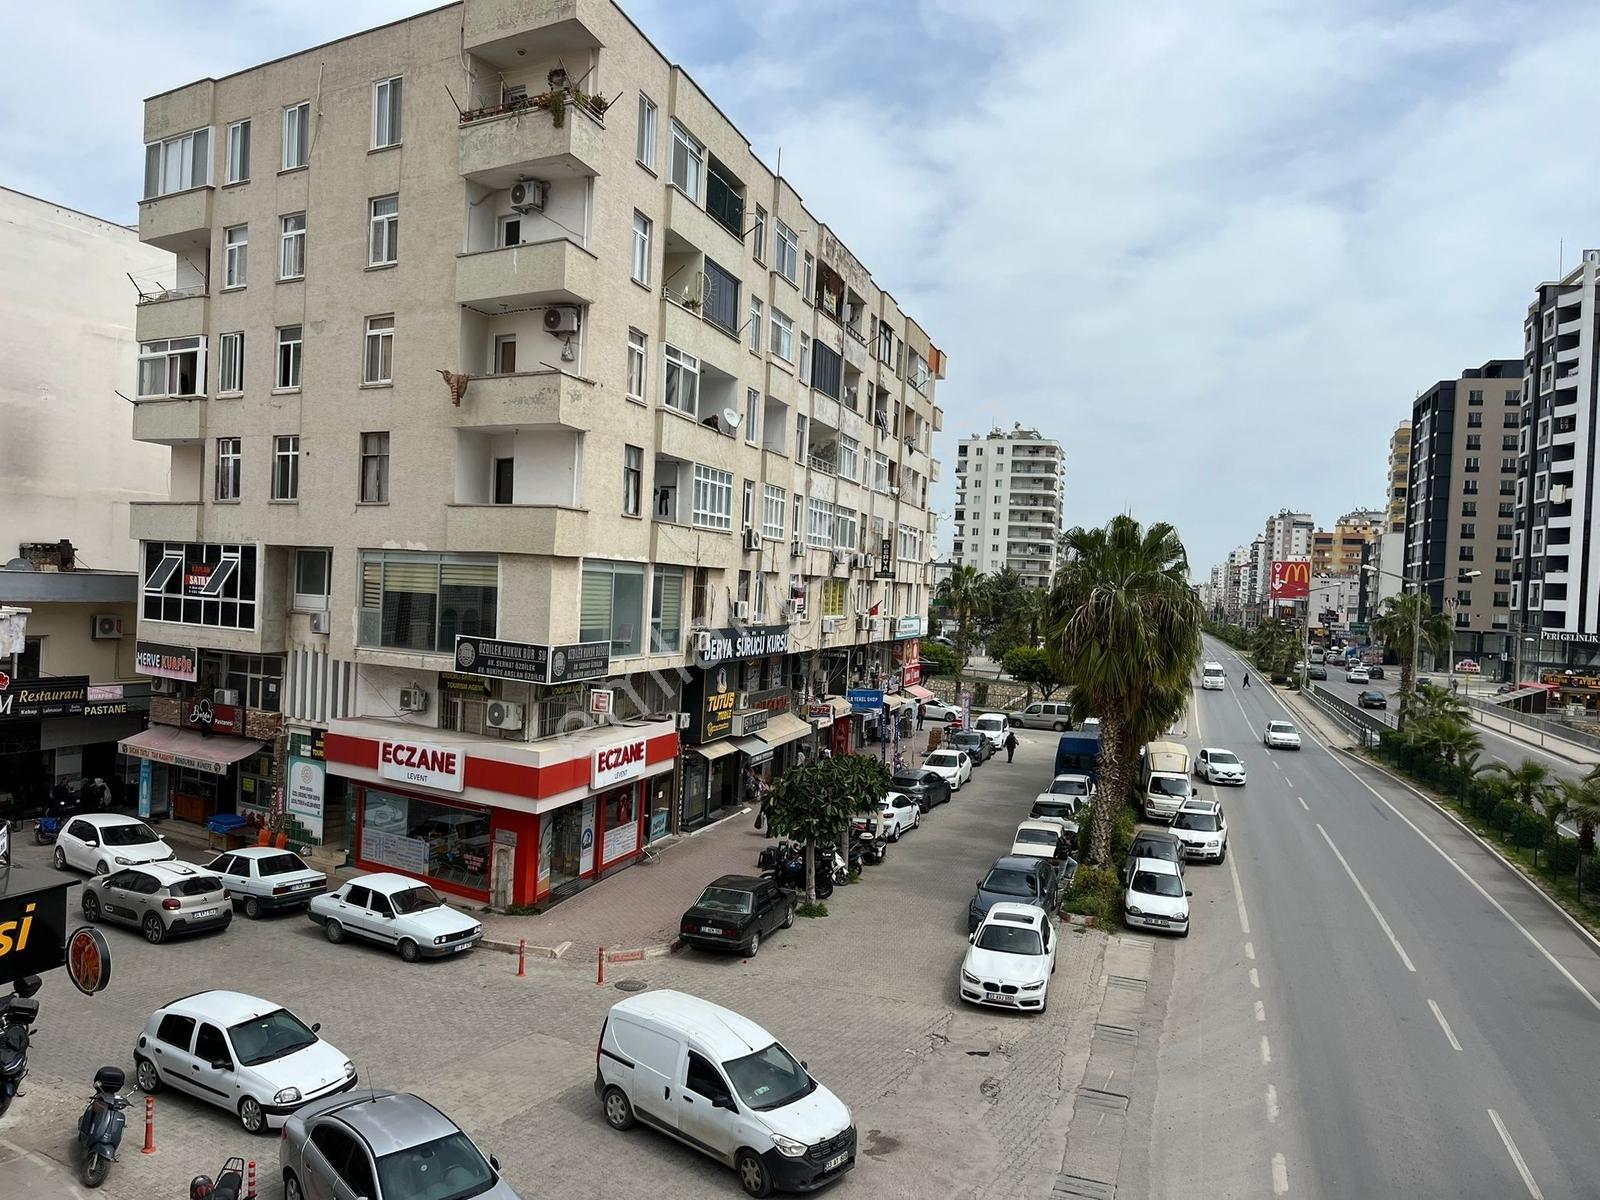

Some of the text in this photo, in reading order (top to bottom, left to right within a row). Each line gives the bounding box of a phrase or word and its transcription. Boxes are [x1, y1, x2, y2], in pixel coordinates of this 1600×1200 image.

[1541, 631, 1598, 643] PERİ GELİNLİK
[478, 640, 502, 655] ÖZDİLEK
[502, 645, 522, 658] HUKUK
[704, 631, 788, 660] DERYA SÜRÜCÜ KURSU
[161, 656, 193, 673] KUAFÖR
[515, 661, 536, 671] ÖZDİLEK
[19, 689, 85, 703] Restaurant
[84, 705, 127, 715] PASTANE
[382, 742, 456, 775] ECZANE
[597, 741, 645, 773] ECZANE
[407, 773, 428, 782] LEVENT
